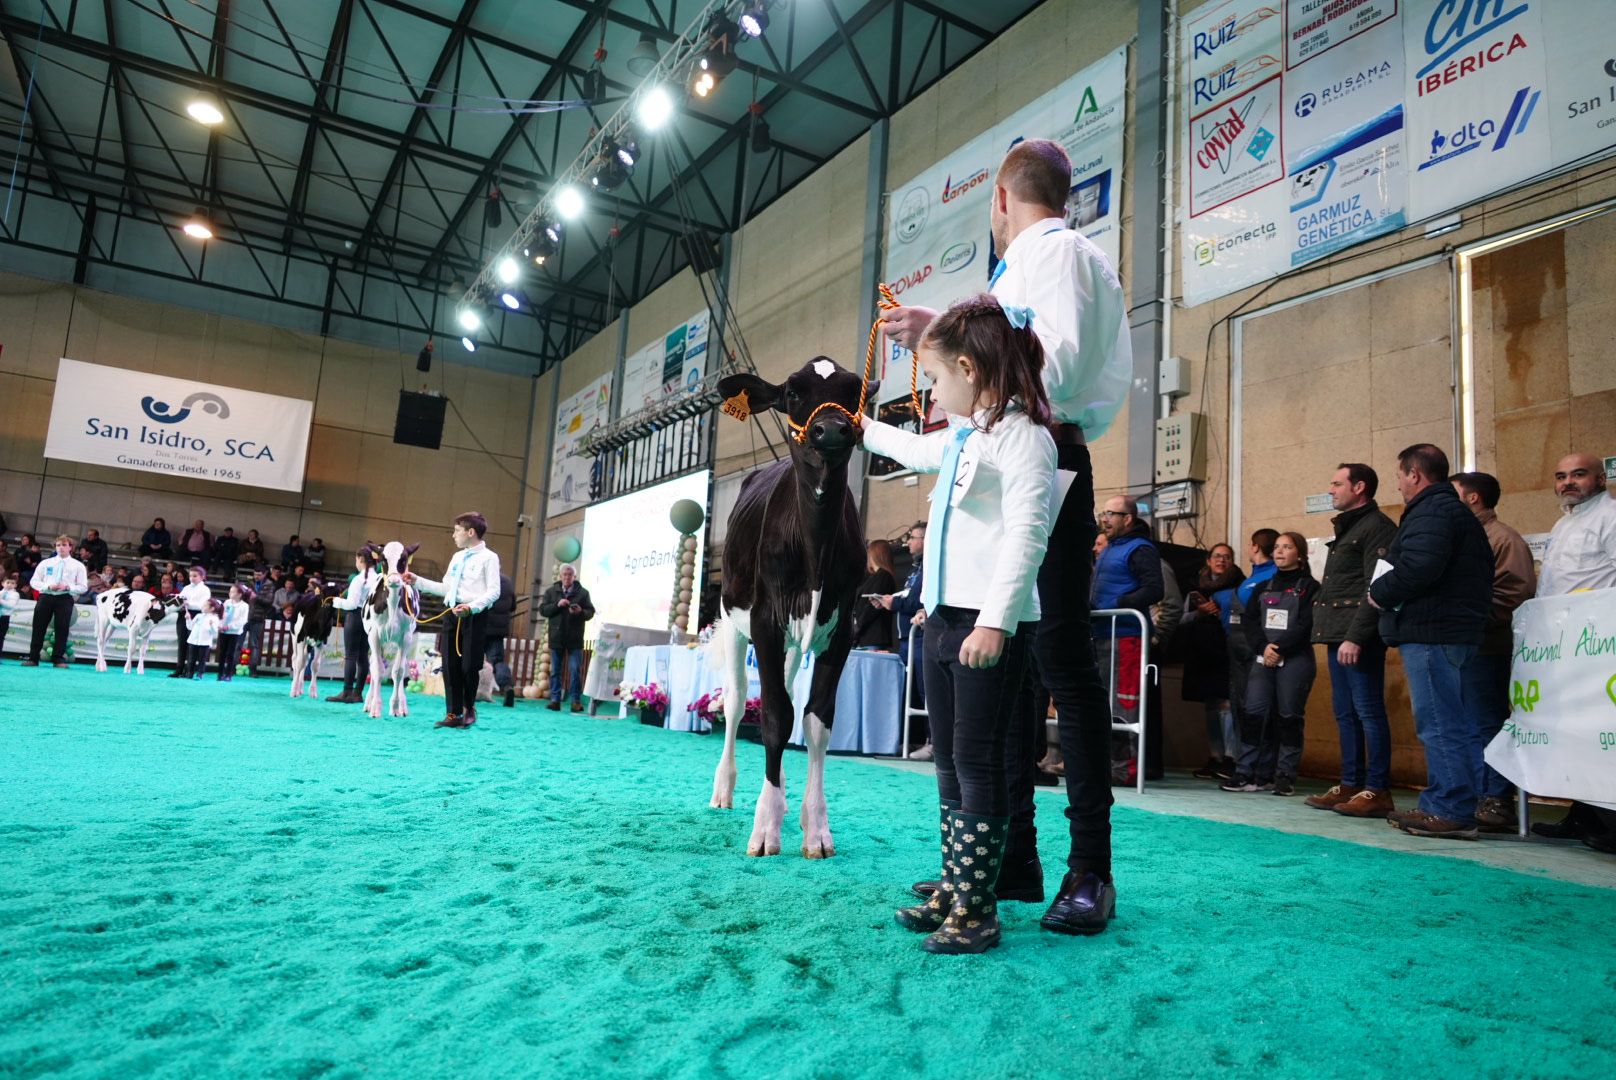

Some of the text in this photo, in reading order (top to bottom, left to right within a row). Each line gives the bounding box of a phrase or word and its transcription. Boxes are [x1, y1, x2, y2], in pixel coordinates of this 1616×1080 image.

[1194, 20, 1237, 60] RUIZ
[1417, 33, 1527, 97] IBÉRICA
[1194, 67, 1237, 105] RUIZ
[1322, 61, 1391, 99] RUSAMA
[1568, 97, 1601, 118] San
[1197, 107, 1245, 169] covial
[1451, 119, 1494, 147] dta
[1073, 155, 1103, 177] DeLaval
[1298, 194, 1362, 231] GARMUZ
[1218, 222, 1276, 251] conecta
[724, 403, 747, 422] 3918
[85, 418, 274, 462] San Isidro, SCA
[117, 454, 241, 480] Ganaderos desde 1965
[955, 461, 970, 488] 2
[624, 546, 678, 574] AgroBank
[1517, 729, 1549, 748] futuro
